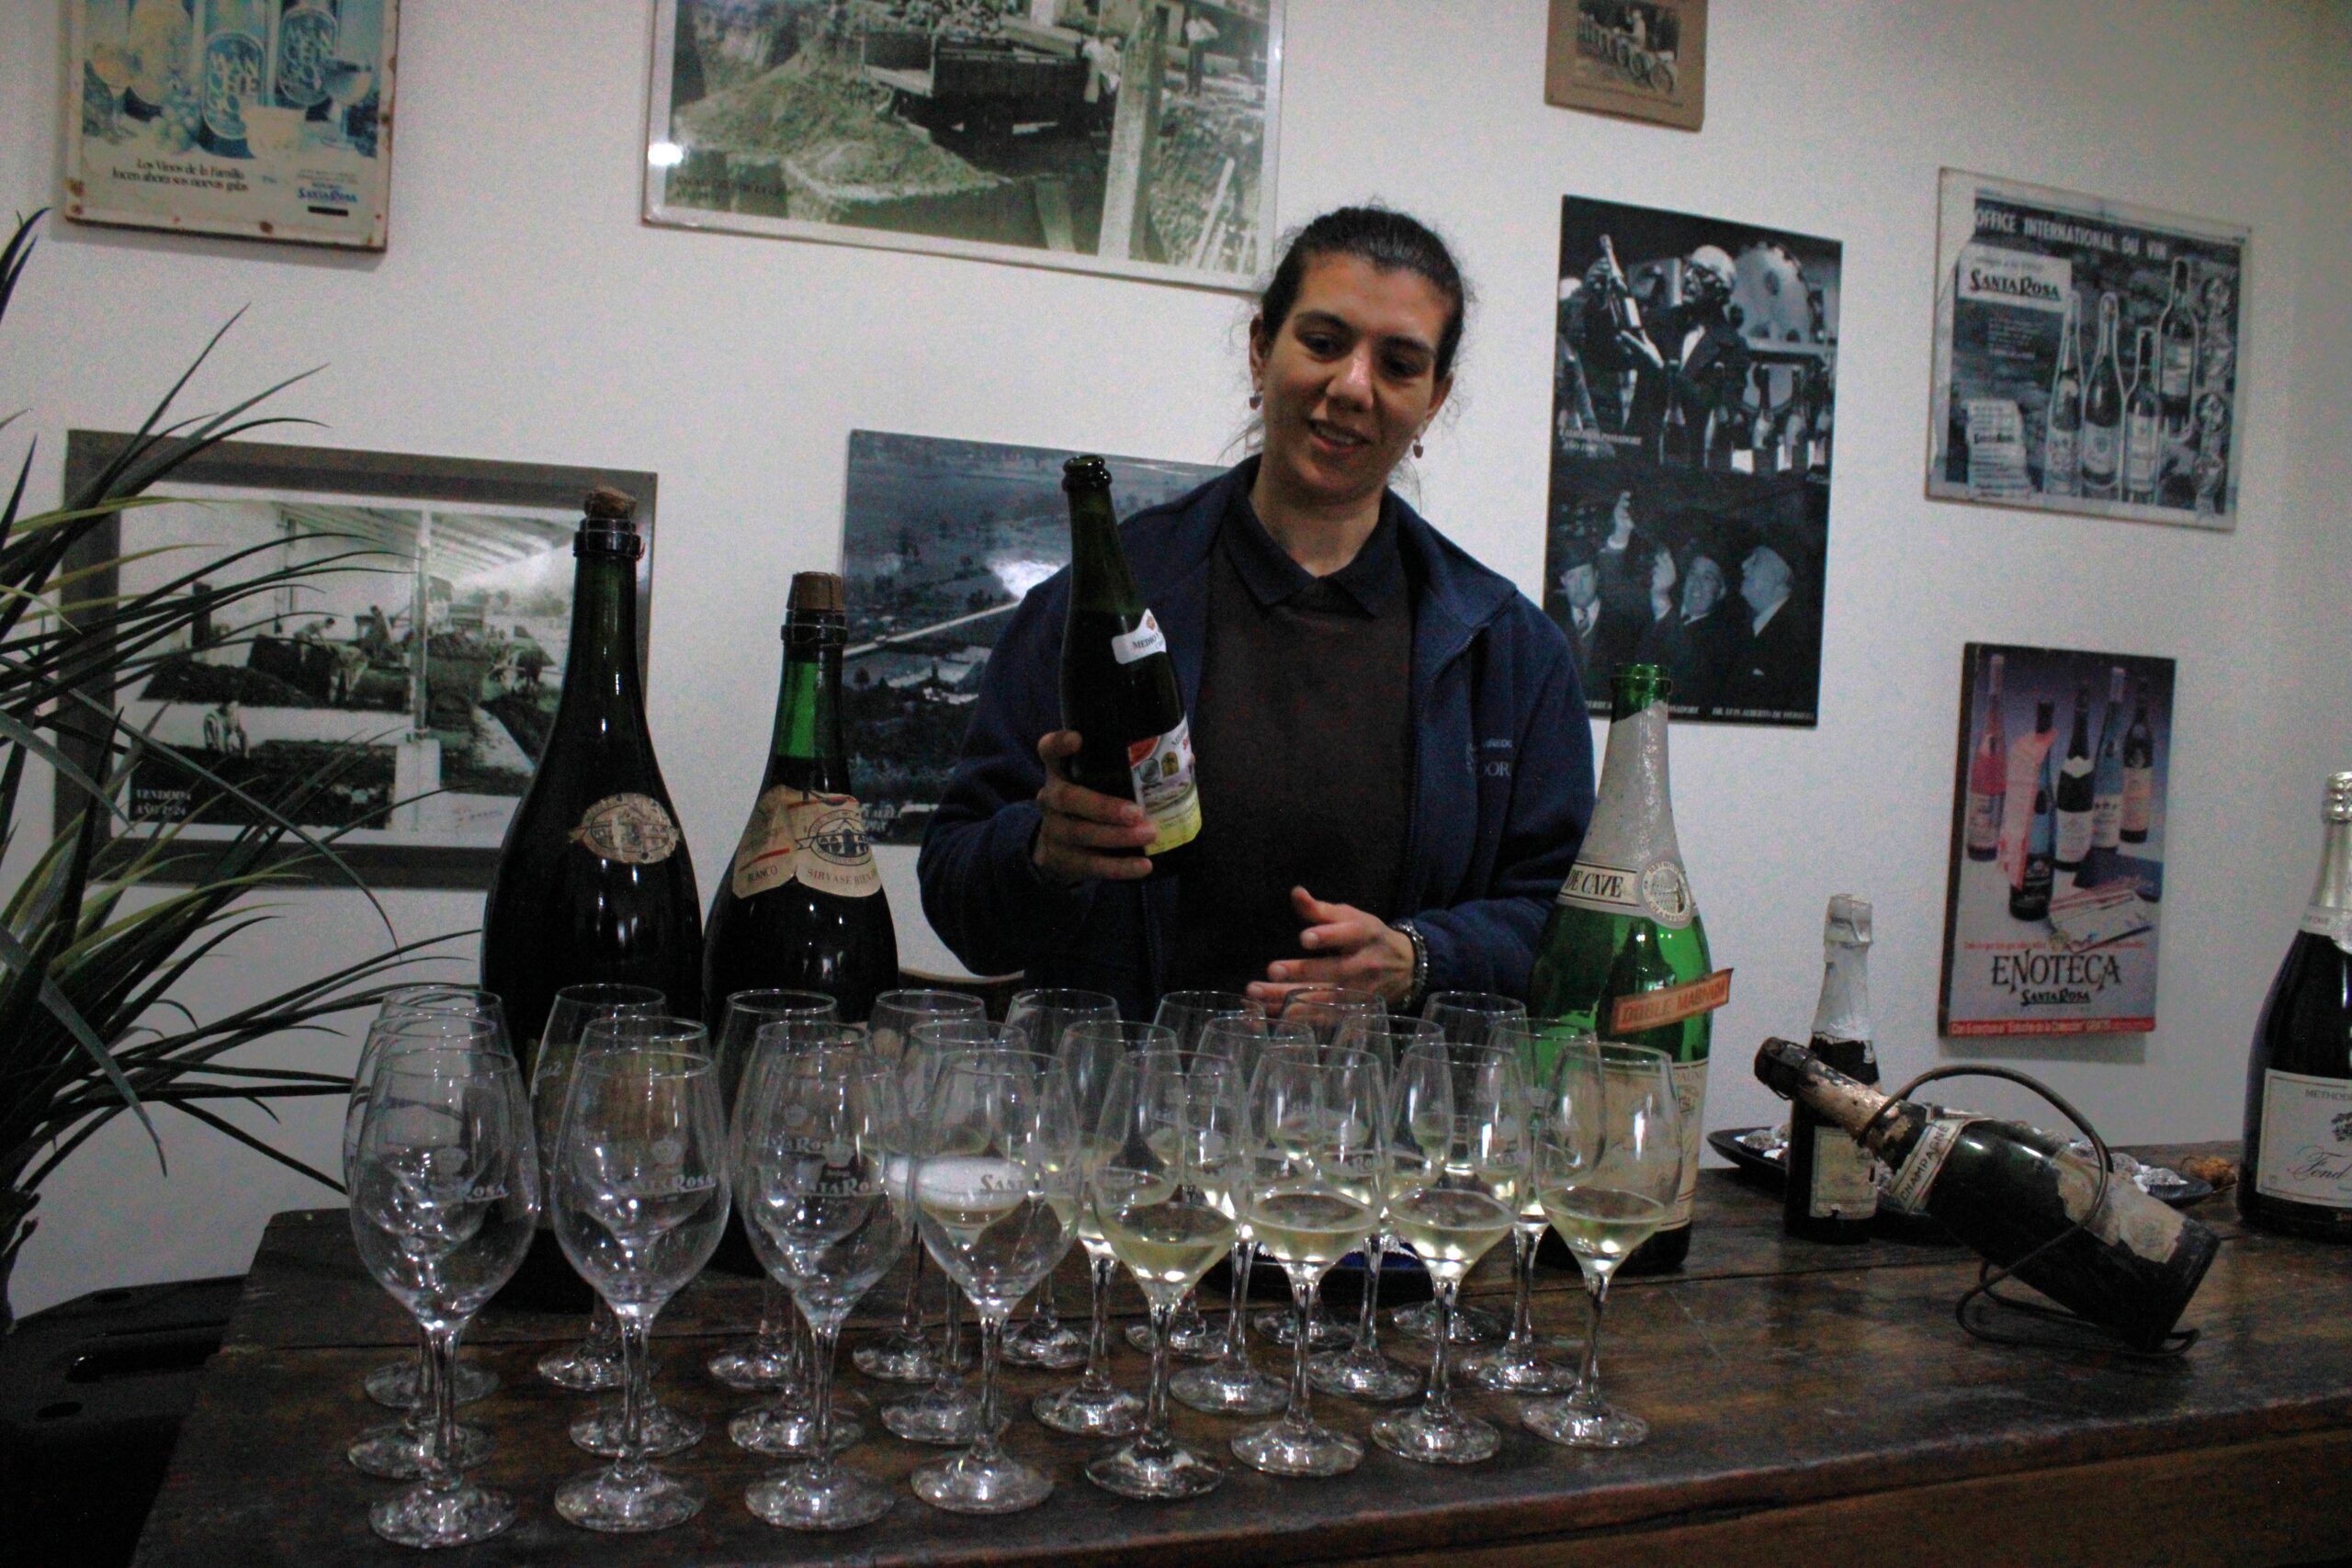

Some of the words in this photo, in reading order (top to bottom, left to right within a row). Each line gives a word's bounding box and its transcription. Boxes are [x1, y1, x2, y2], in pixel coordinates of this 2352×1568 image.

[1975, 207, 2017, 233] OFFICE
[2023, 216, 2114, 253] INTERNATIONAL
[747, 865, 778, 884] BLANCO
[1581, 873, 1624, 898] CAVE
[1991, 948, 2121, 994] ENOTECA
[1900, 1122, 1951, 1201] CHAMPAGNE
